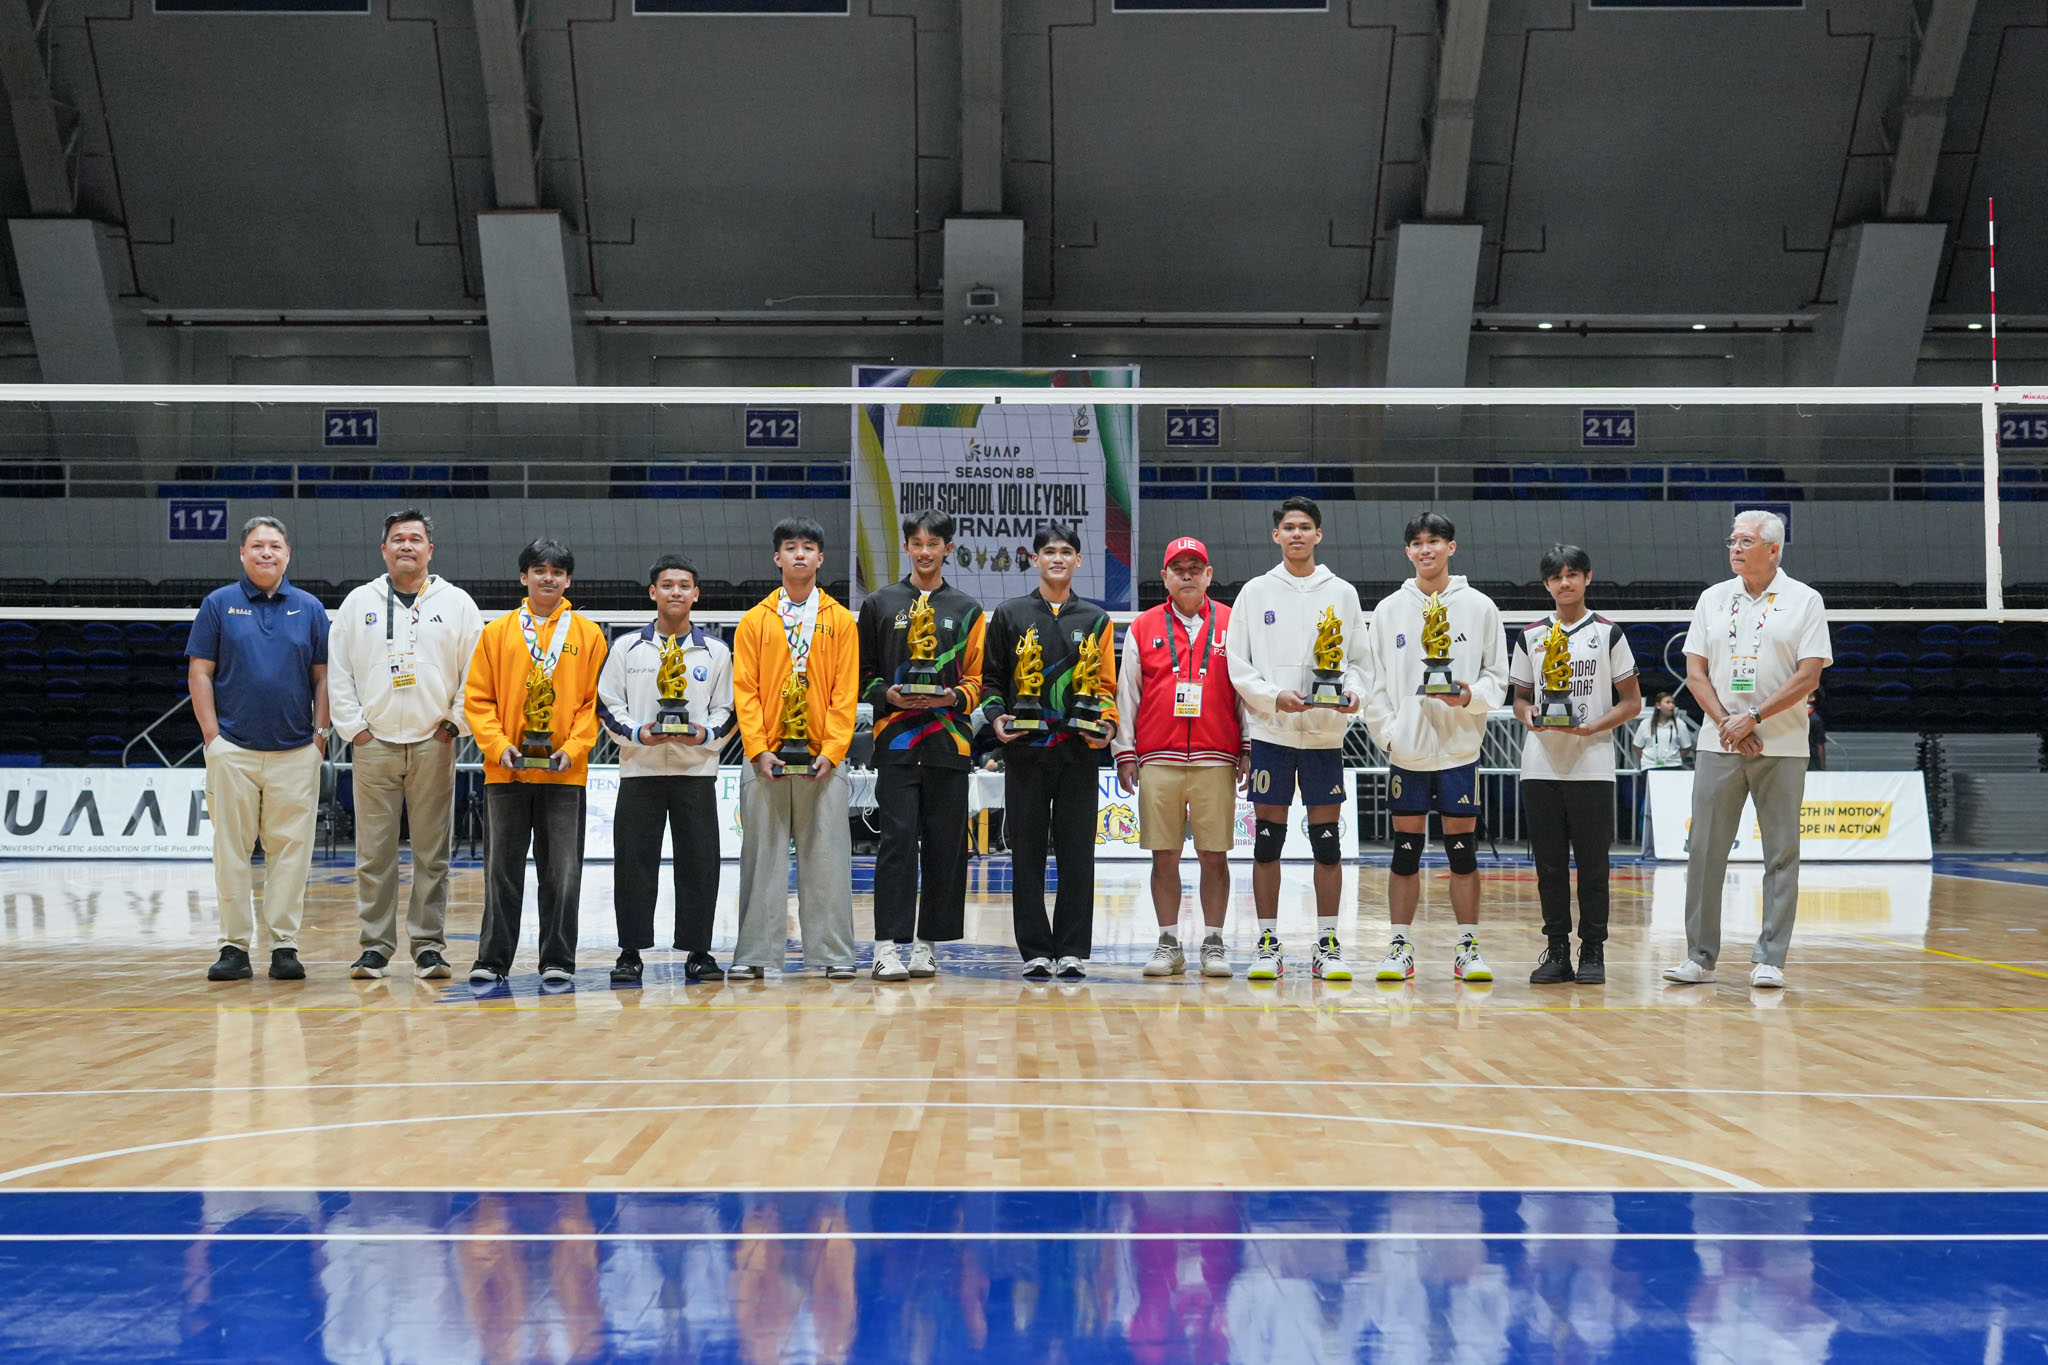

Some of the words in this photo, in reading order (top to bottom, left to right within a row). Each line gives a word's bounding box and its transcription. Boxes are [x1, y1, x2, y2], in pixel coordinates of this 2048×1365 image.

[329, 418, 373, 437] 211
[749, 418, 796, 438] 212
[1169, 417, 1216, 437] 213
[1585, 418, 1632, 437] 214
[2002, 420, 2048, 439] 215
[983, 446, 1021, 458] UAAP
[955, 466, 1013, 479] SEASON
[1016, 467, 1035, 479] 88
[900, 482, 935, 515] HIGH
[938, 483, 995, 515] SCHOOL
[998, 483, 1089, 516] VOLLEYBALL
[174, 510, 224, 530] 117
[1177, 539, 1197, 550] UE
[1211, 628, 1227, 648] U
[561, 643, 579, 656] EU
[1213, 647, 1226, 657] PZ
[588, 778, 618, 790] TEN
[1250, 768, 1271, 794] 10
[1391, 775, 1402, 799] 6
[1800, 807, 1821, 816] GTH
[1824, 807, 1835, 816] IN
[1838, 807, 1885, 818] MOTION,
[1800, 824, 1821, 834] OPE
[1824, 824, 1835, 834] IN
[1839, 824, 1881, 834] ACTION
[47, 844, 85, 853] ATHLETIC
[87, 844, 139, 853] ASSOCIATION
[142, 844, 151, 853] OF
[153, 844, 170, 853] THE
[171, 844, 213, 853] PHILIPPIN
